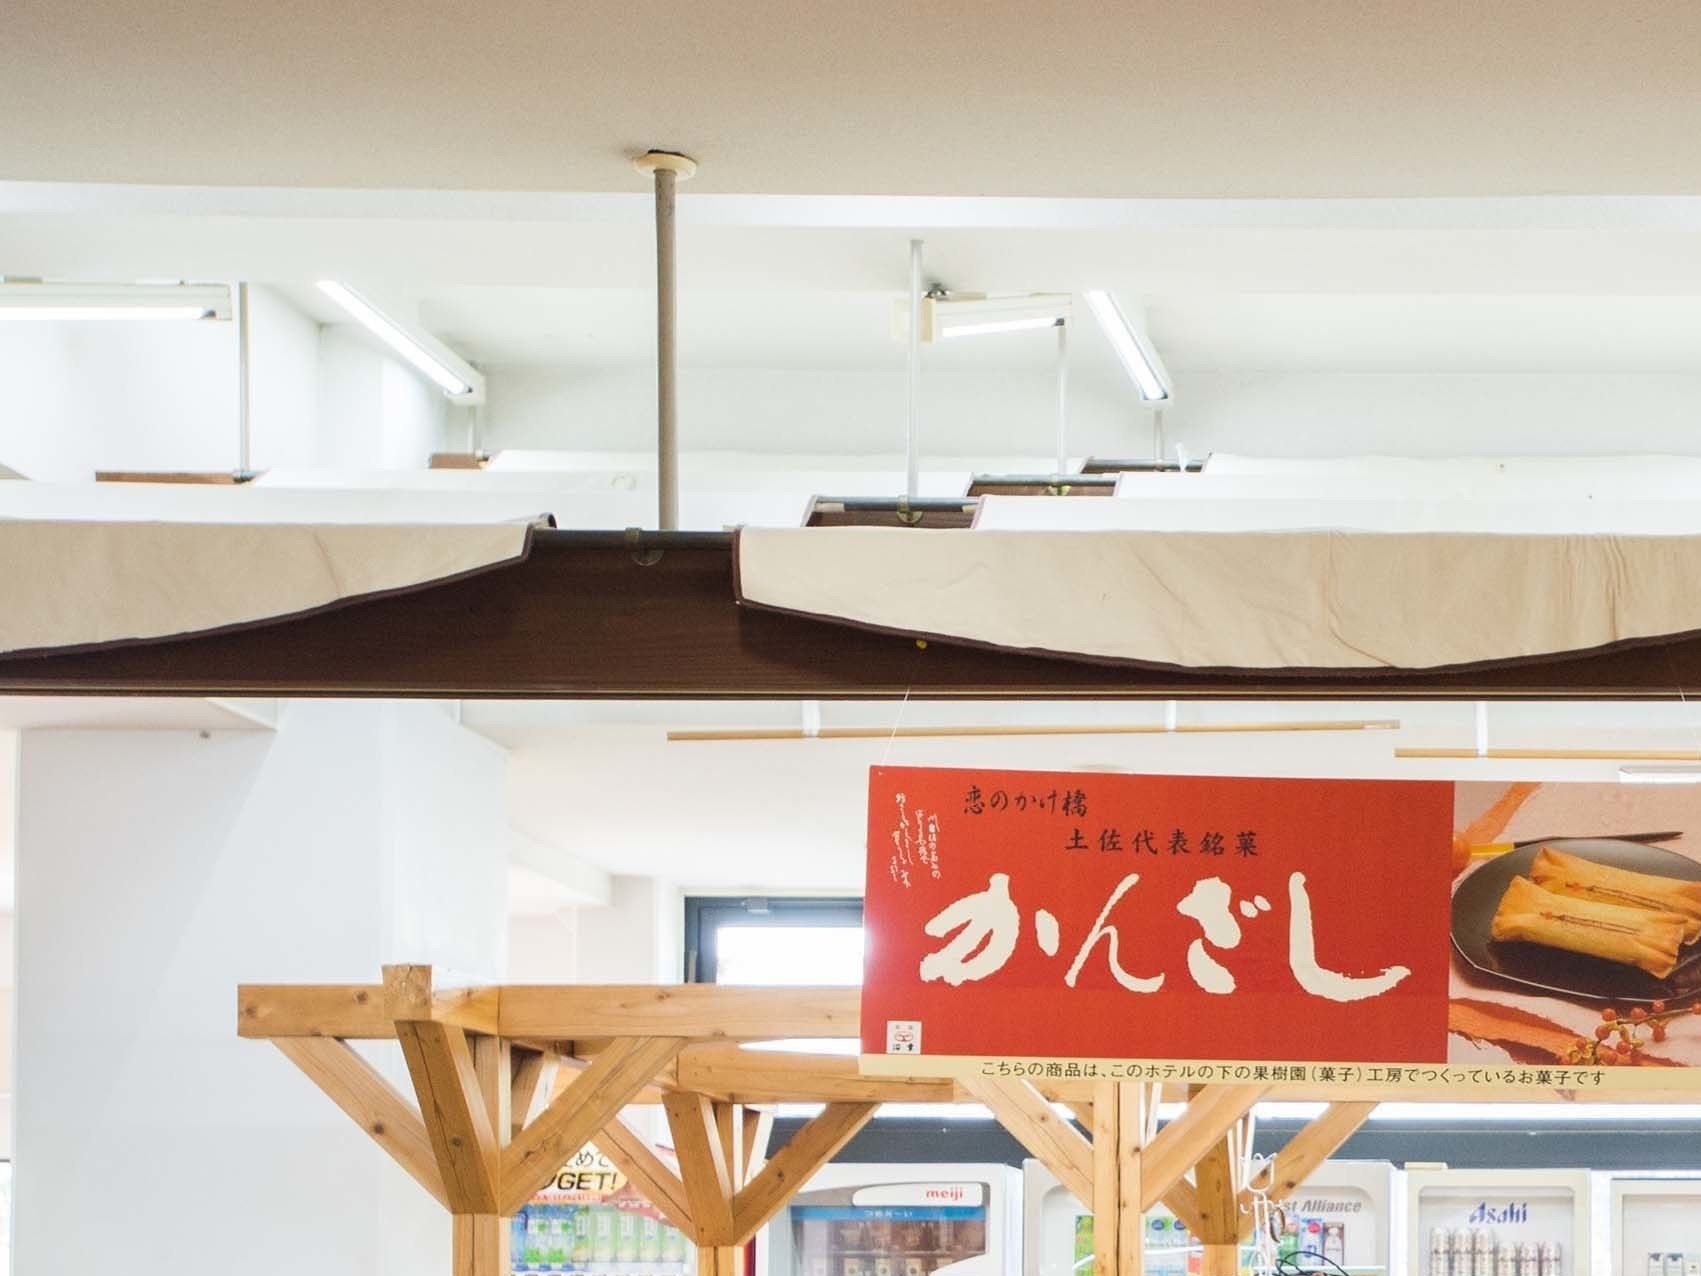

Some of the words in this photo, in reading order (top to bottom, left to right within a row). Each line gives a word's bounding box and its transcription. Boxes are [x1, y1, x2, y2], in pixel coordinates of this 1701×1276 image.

[963, 785, 1087, 817] 恋のかけ橋
[1065, 829, 1258, 857] 土佐代表銘菓
[919, 871, 1412, 1003] かんざし
[926, 1186, 964, 1201] meiji
[1301, 1200, 1362, 1214] Alliance
[1469, 1202, 1528, 1225] Asahi
